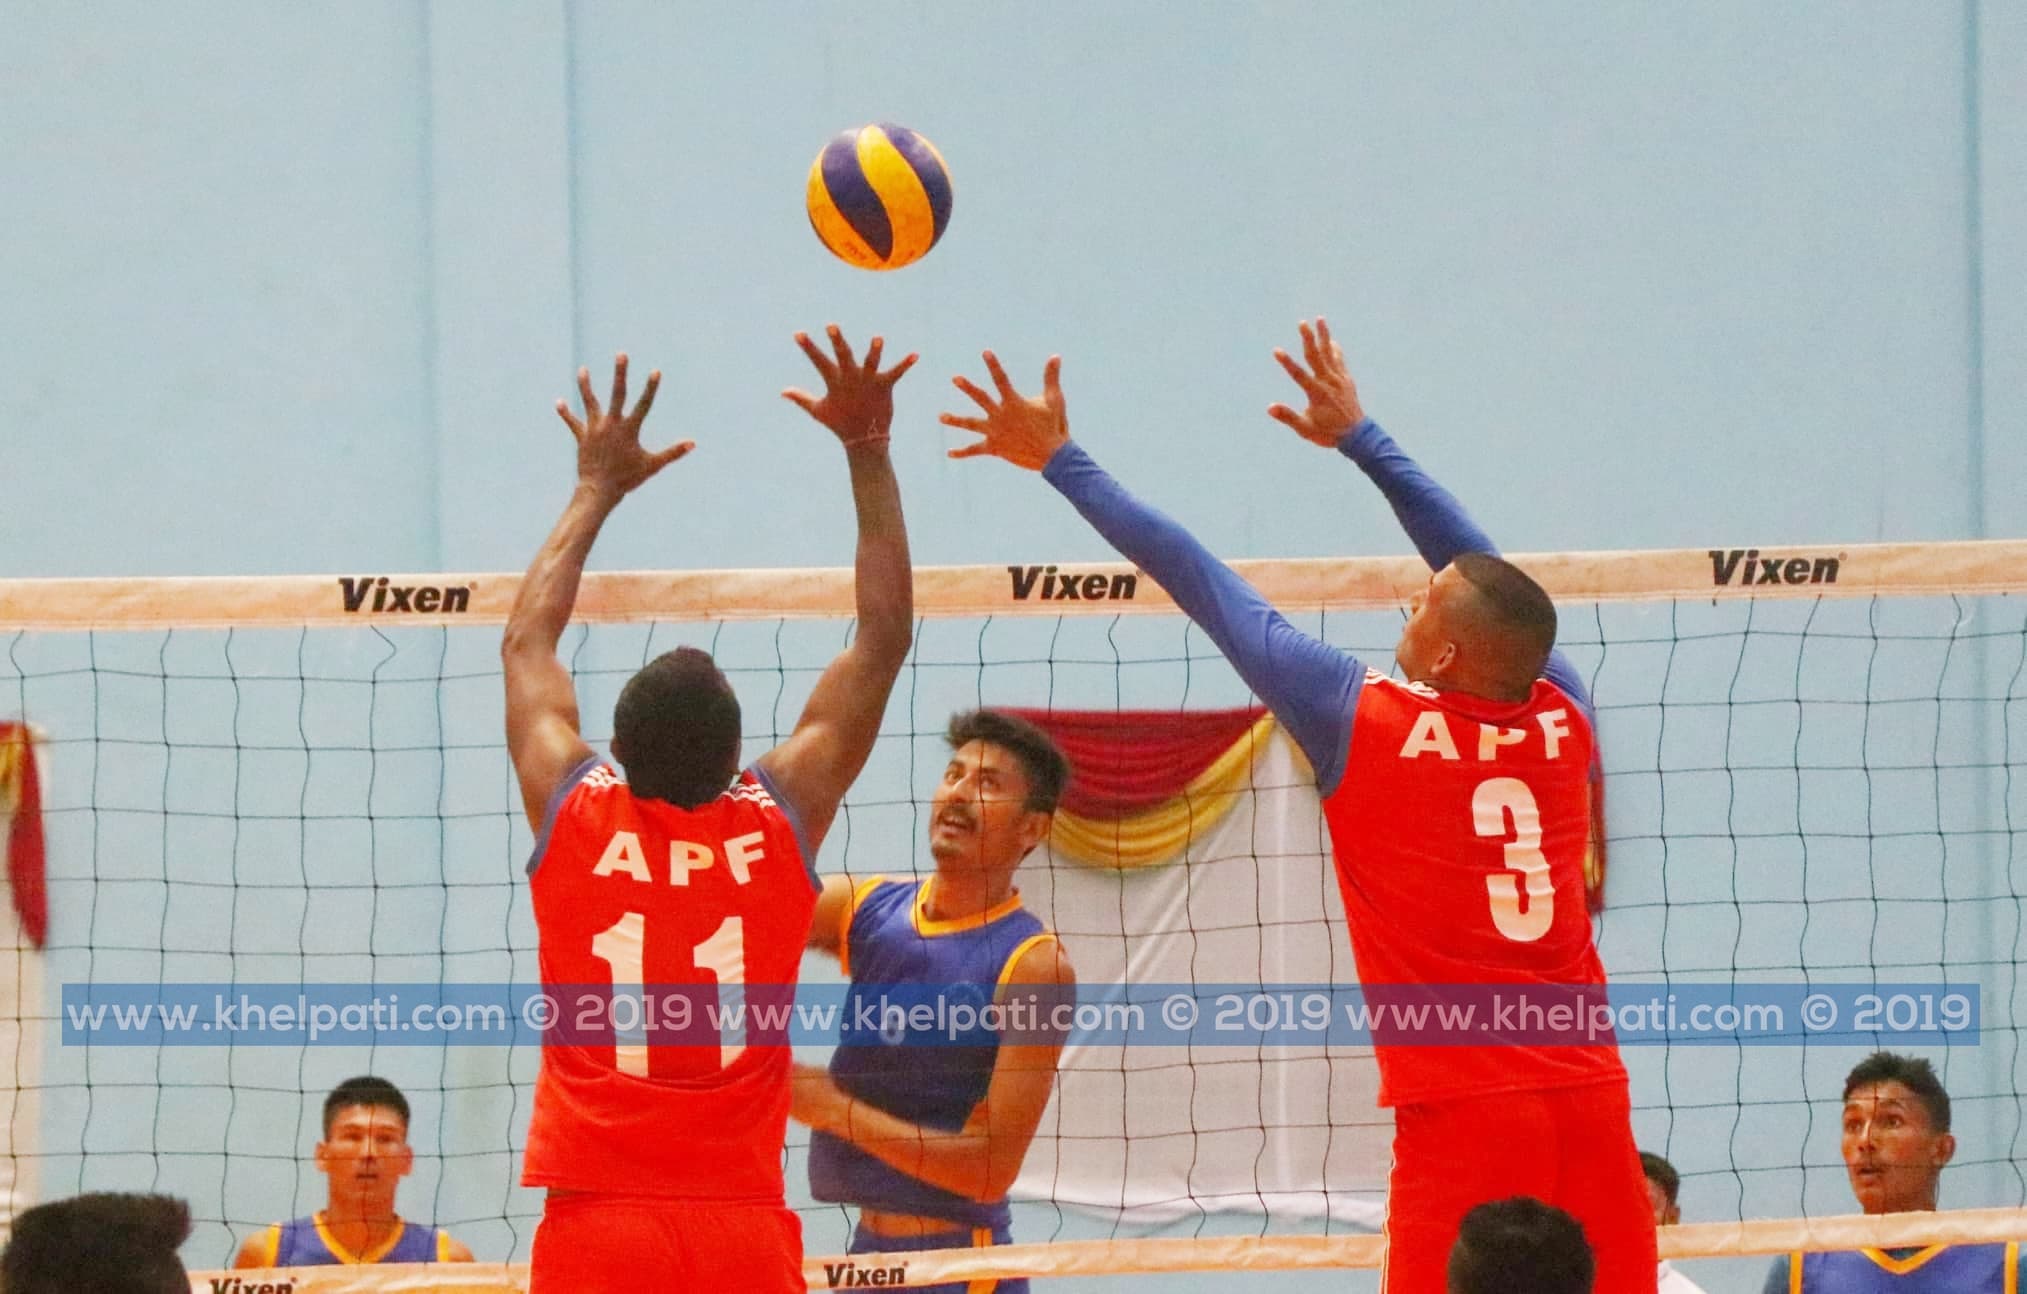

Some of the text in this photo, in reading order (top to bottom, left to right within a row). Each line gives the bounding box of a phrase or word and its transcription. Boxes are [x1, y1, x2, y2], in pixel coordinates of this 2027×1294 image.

[1007, 565, 1137, 600] Vixen
[1708, 549, 1839, 585] Vixen
[338, 577, 470, 613] Vixen
[1399, 708, 1570, 761] APF
[592, 830, 765, 886] APF
[1472, 777, 1556, 942] 3
[592, 911, 748, 1078] 11
[823, 1262, 905, 1289] Vixen
